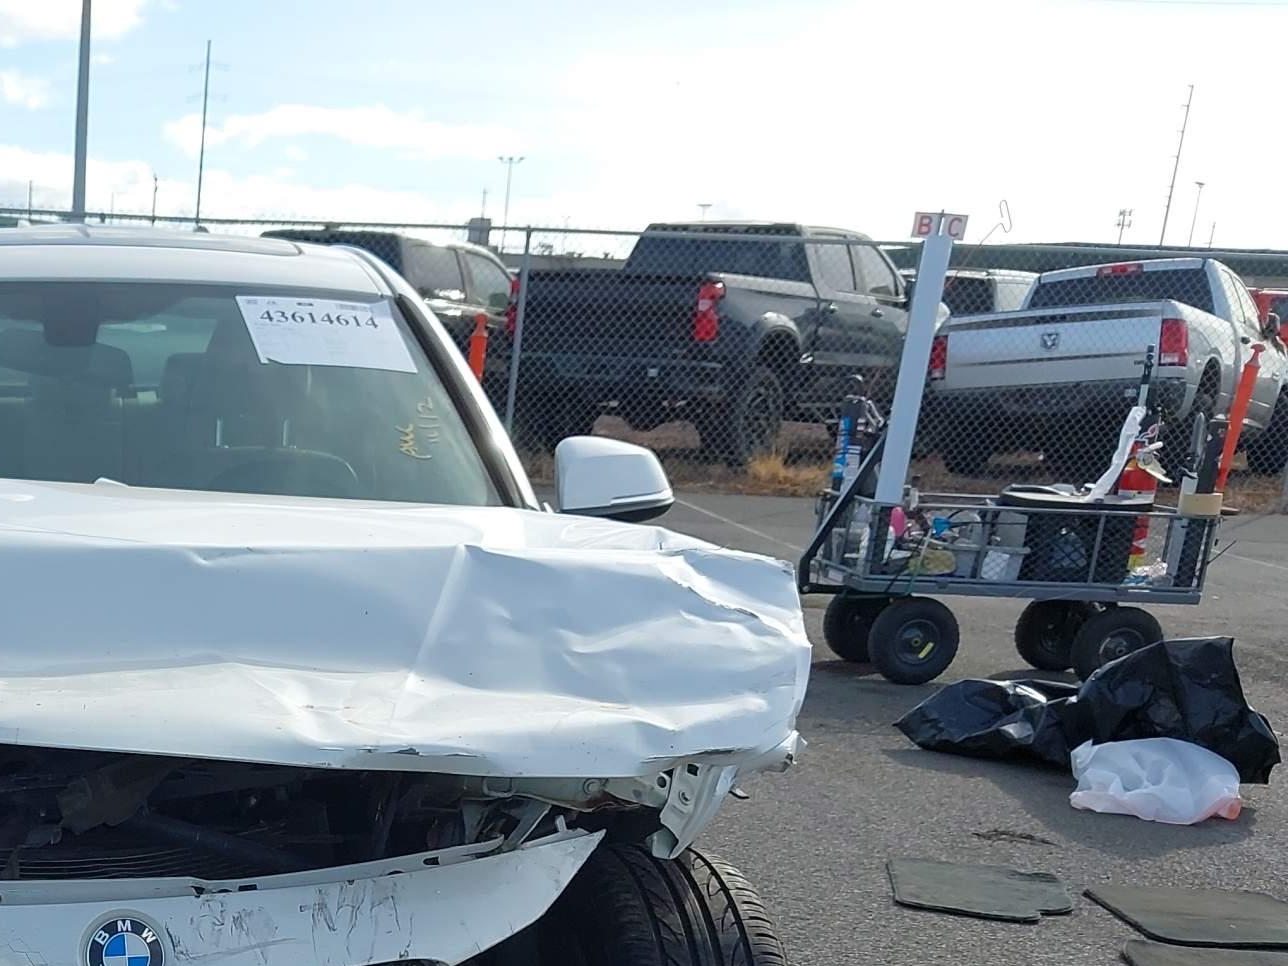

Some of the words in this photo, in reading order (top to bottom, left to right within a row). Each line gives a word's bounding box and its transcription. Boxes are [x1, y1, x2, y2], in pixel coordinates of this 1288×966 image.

[918, 215, 933, 236] B
[948, 217, 963, 237] C
[259, 309, 379, 329] 43614614
[94, 919, 157, 946] BMW
